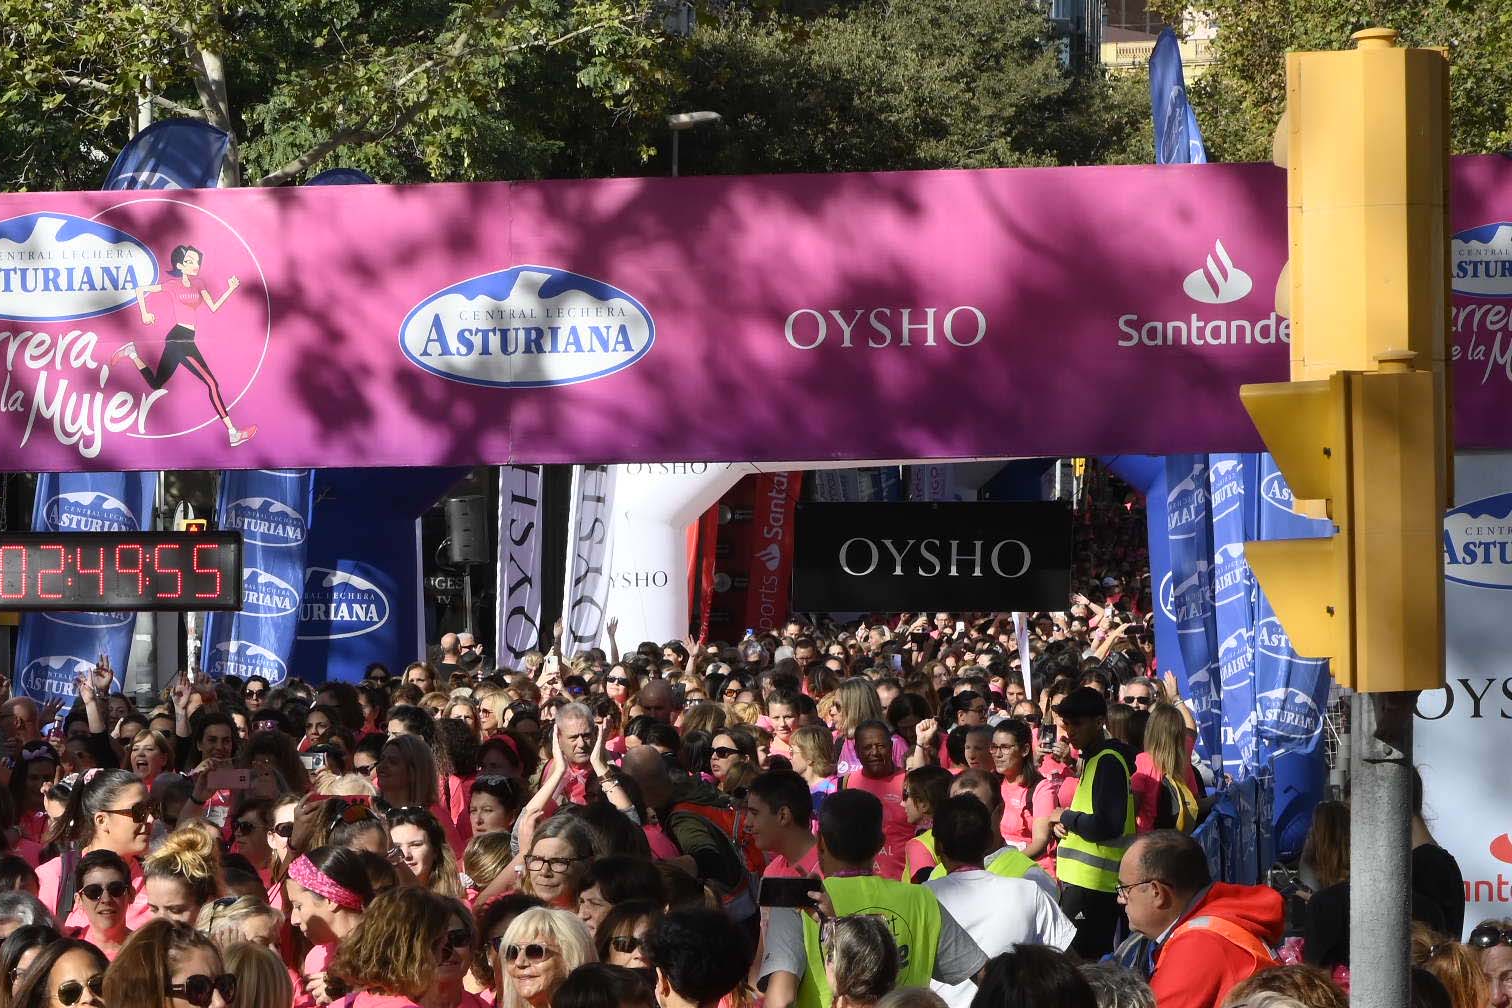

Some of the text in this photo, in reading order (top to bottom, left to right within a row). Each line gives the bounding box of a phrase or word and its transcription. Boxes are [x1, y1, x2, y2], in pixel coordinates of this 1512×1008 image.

[60, 249, 135, 261] LECHERA
[419, 313, 636, 358] ASTURIANA
[459, 306, 627, 321] CENTRAL LECHERA
[783, 304, 988, 350] OYSHO
[1117, 311, 1291, 347] Santande
[0, 373, 25, 413] la
[19, 364, 169, 459] Mujer
[0, 544, 221, 598] 02:49:55
[505, 465, 540, 660] OYSH
[569, 465, 608, 644] OYSH
[838, 536, 1033, 578] OYSHO
[608, 569, 669, 589] YSHO
